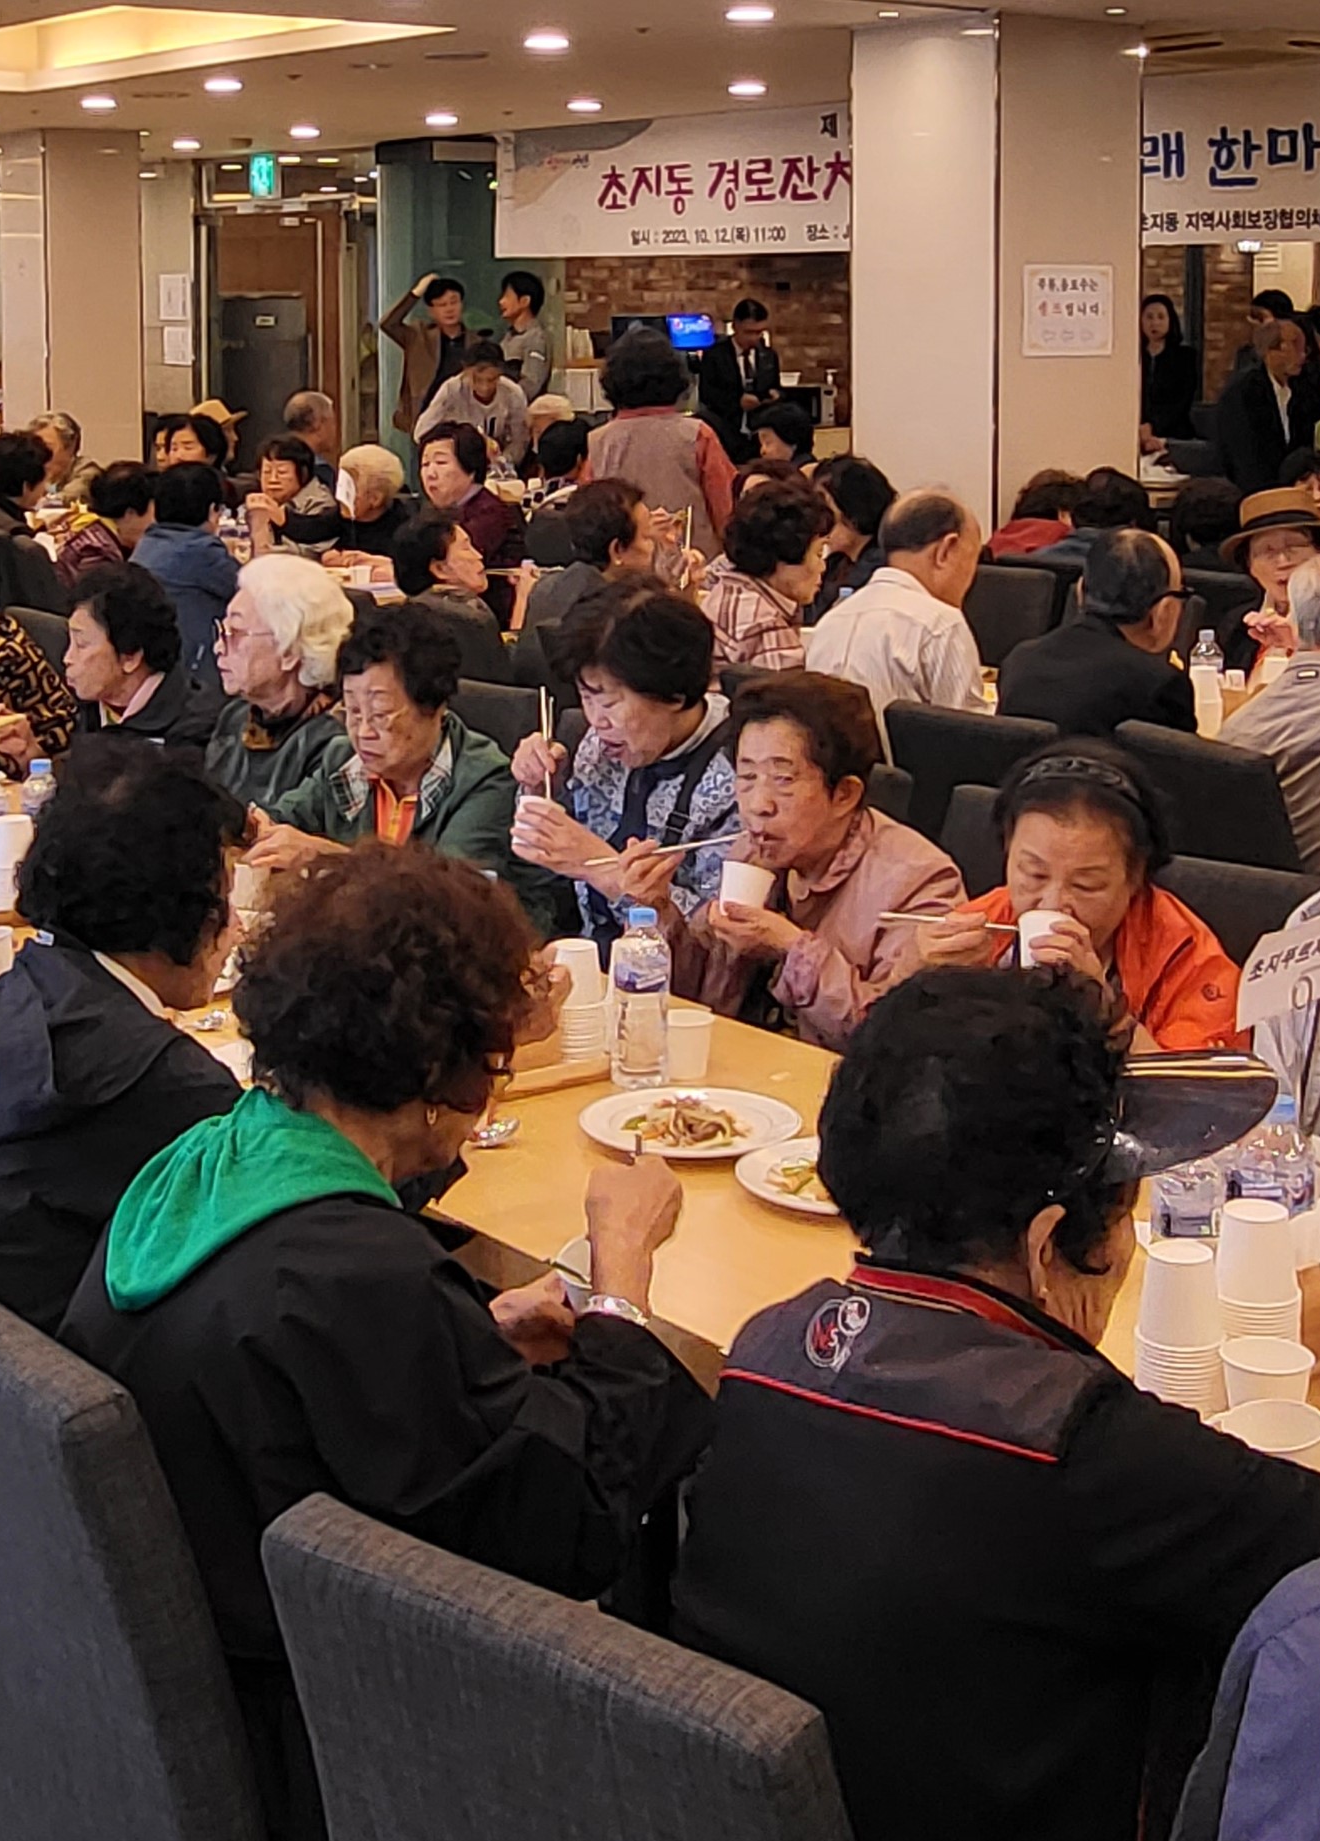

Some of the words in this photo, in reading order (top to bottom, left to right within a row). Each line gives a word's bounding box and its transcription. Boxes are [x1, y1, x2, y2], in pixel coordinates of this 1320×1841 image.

[597, 163, 694, 215] 초지동
[631, 229, 650, 245] 일시
[806, 224, 830, 241] 장소
